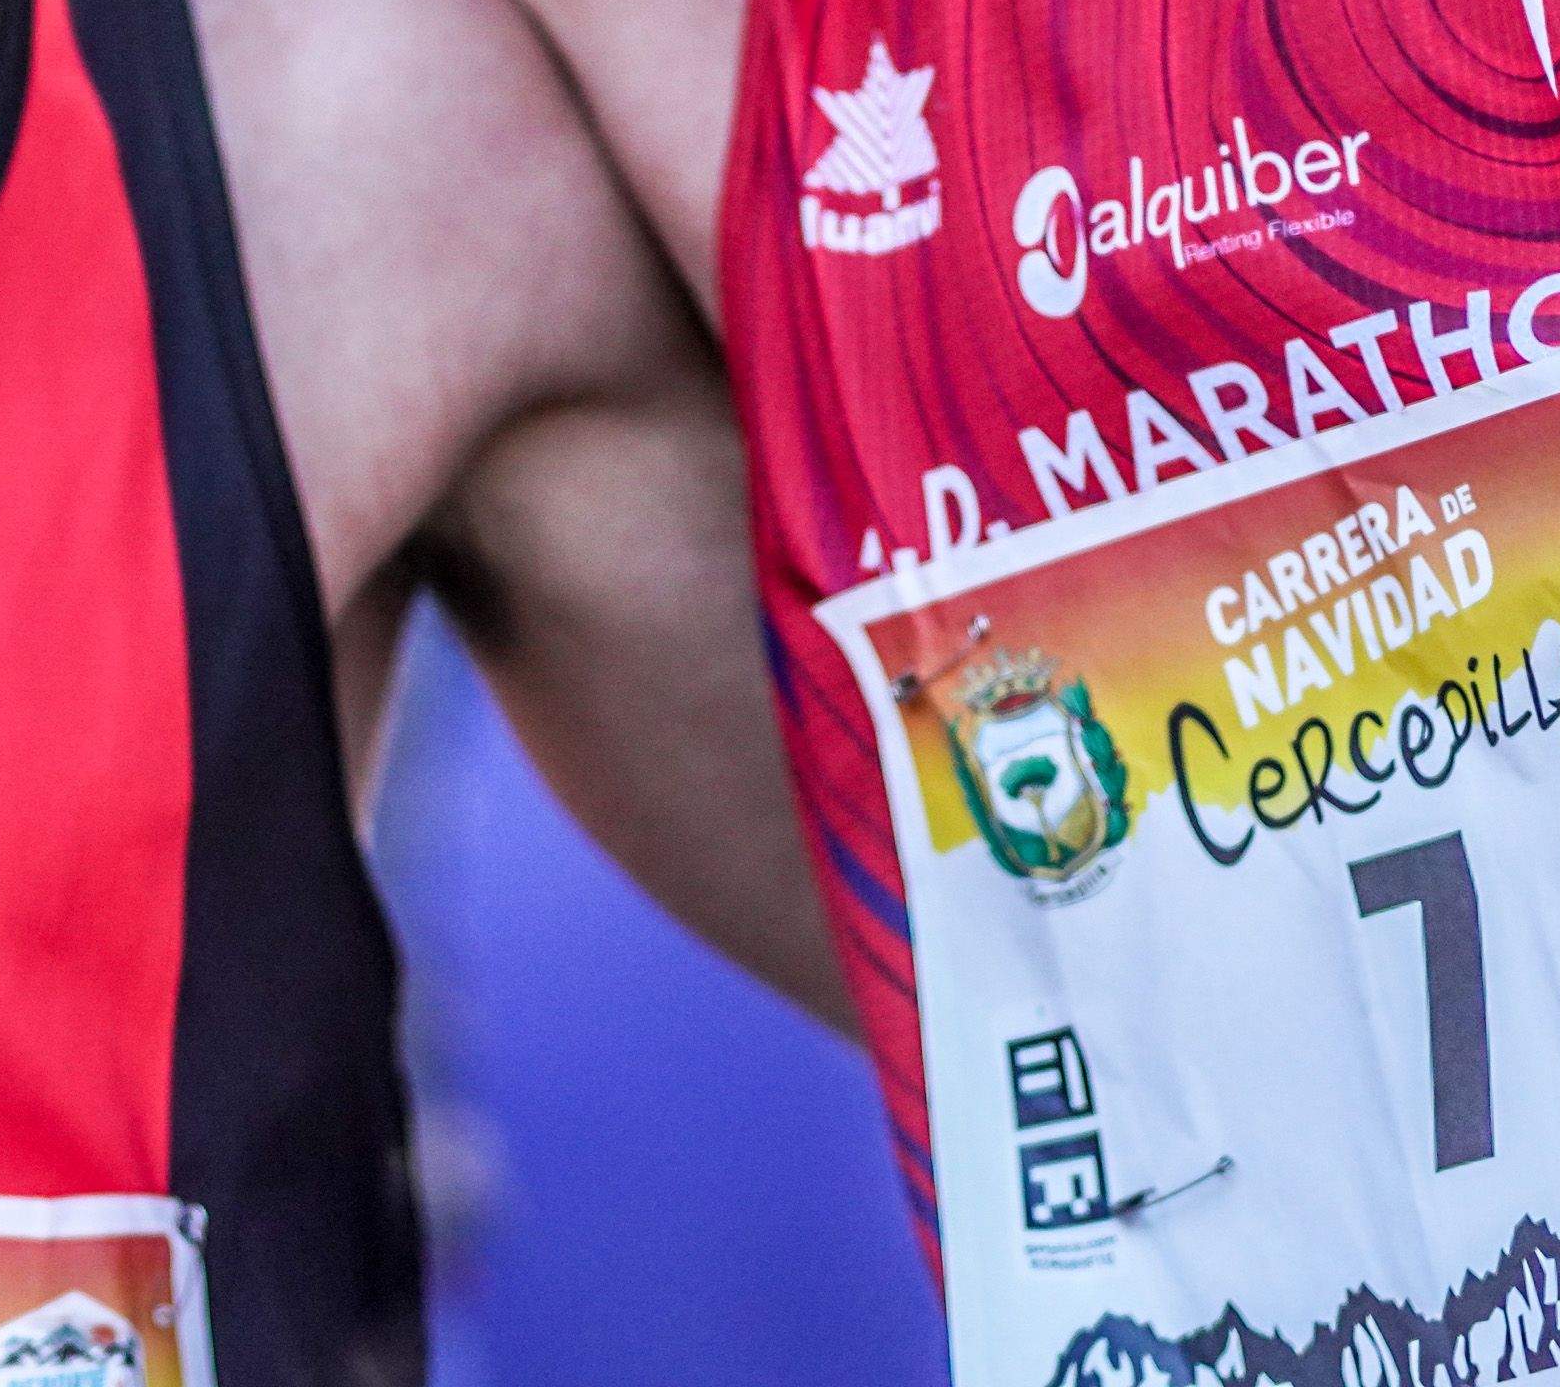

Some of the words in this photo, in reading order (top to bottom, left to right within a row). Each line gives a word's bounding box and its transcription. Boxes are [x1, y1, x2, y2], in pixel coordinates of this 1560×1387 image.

[1088, 116, 1371, 270] alquiber
[1267, 208, 1356, 239] Flexible
[1204, 484, 1436, 647] CARRERA
[1440, 482, 1477, 524] DE
[1222, 528, 1495, 728] NAVIDAD
[1349, 830, 1496, 1172] 7
